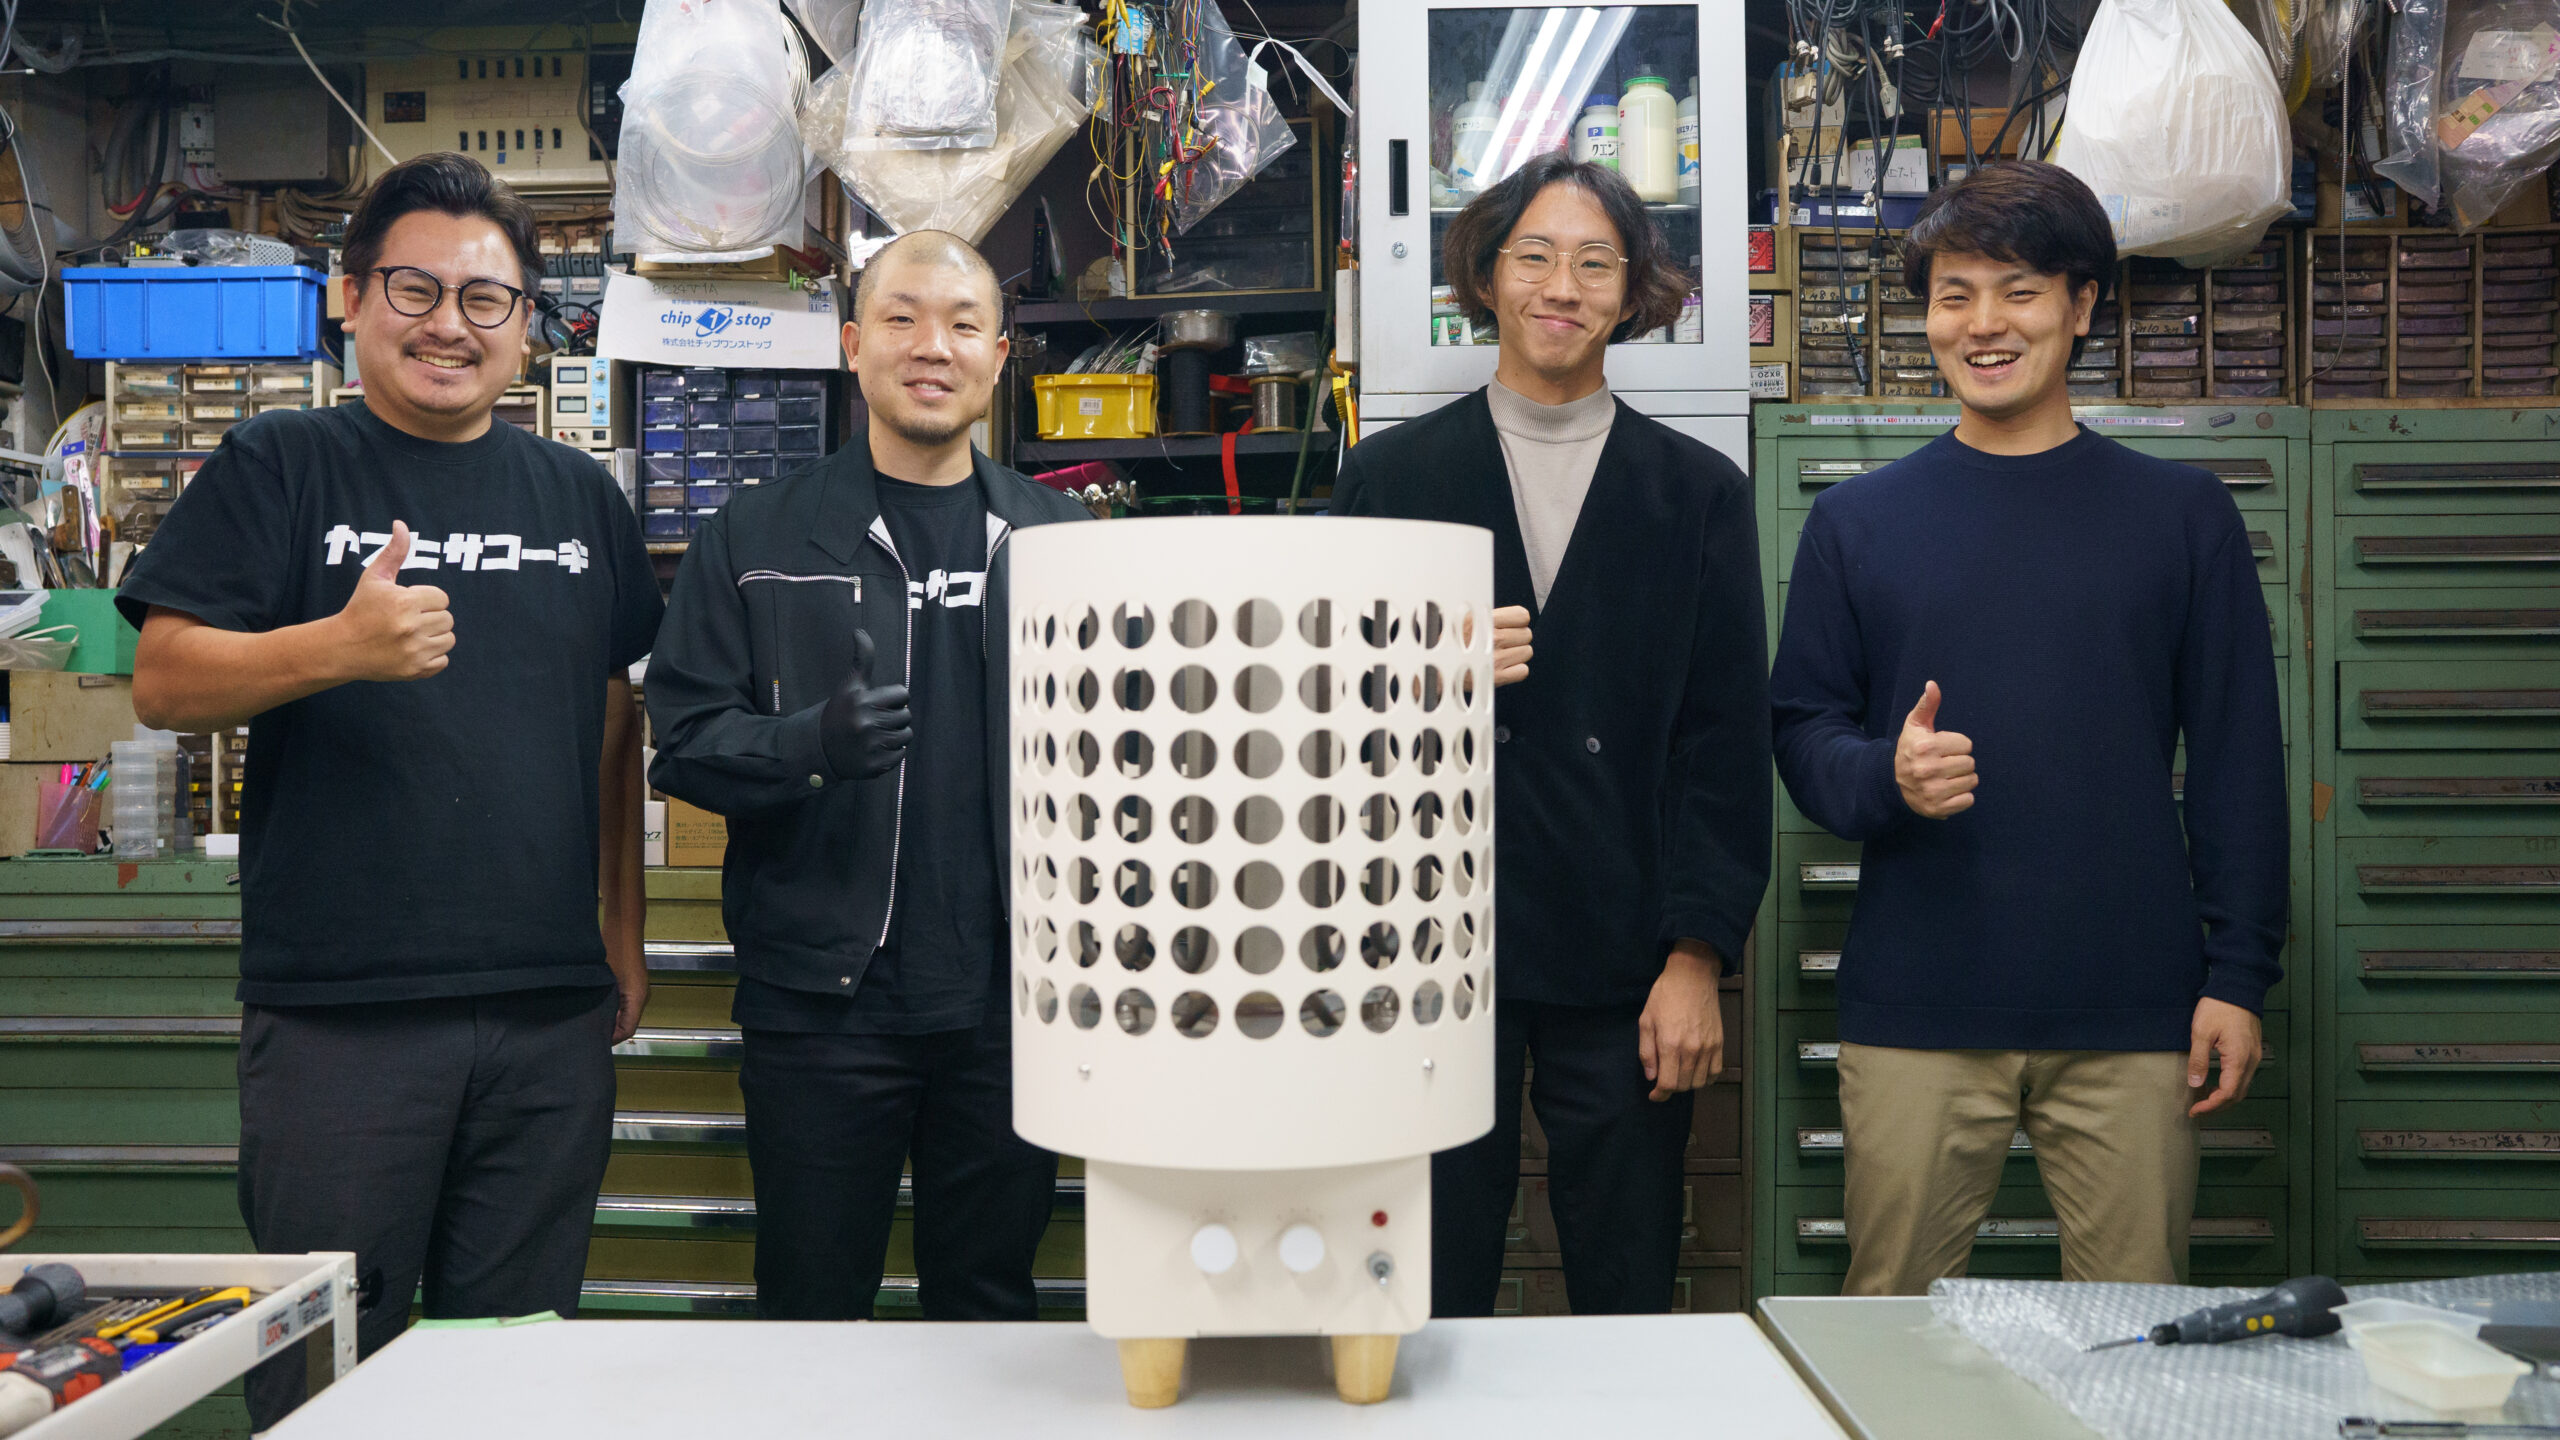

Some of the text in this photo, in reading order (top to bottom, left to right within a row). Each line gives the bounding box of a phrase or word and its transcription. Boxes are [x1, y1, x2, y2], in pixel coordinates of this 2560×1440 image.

[1592, 128, 1599, 136] P
[1592, 143, 1619, 157] クエン
[660, 310, 692, 327] chip
[735, 312, 772, 329] stop
[662, 338, 772, 350] 株式会社チップワンストップ
[1907, 355, 1926, 365] SUS
